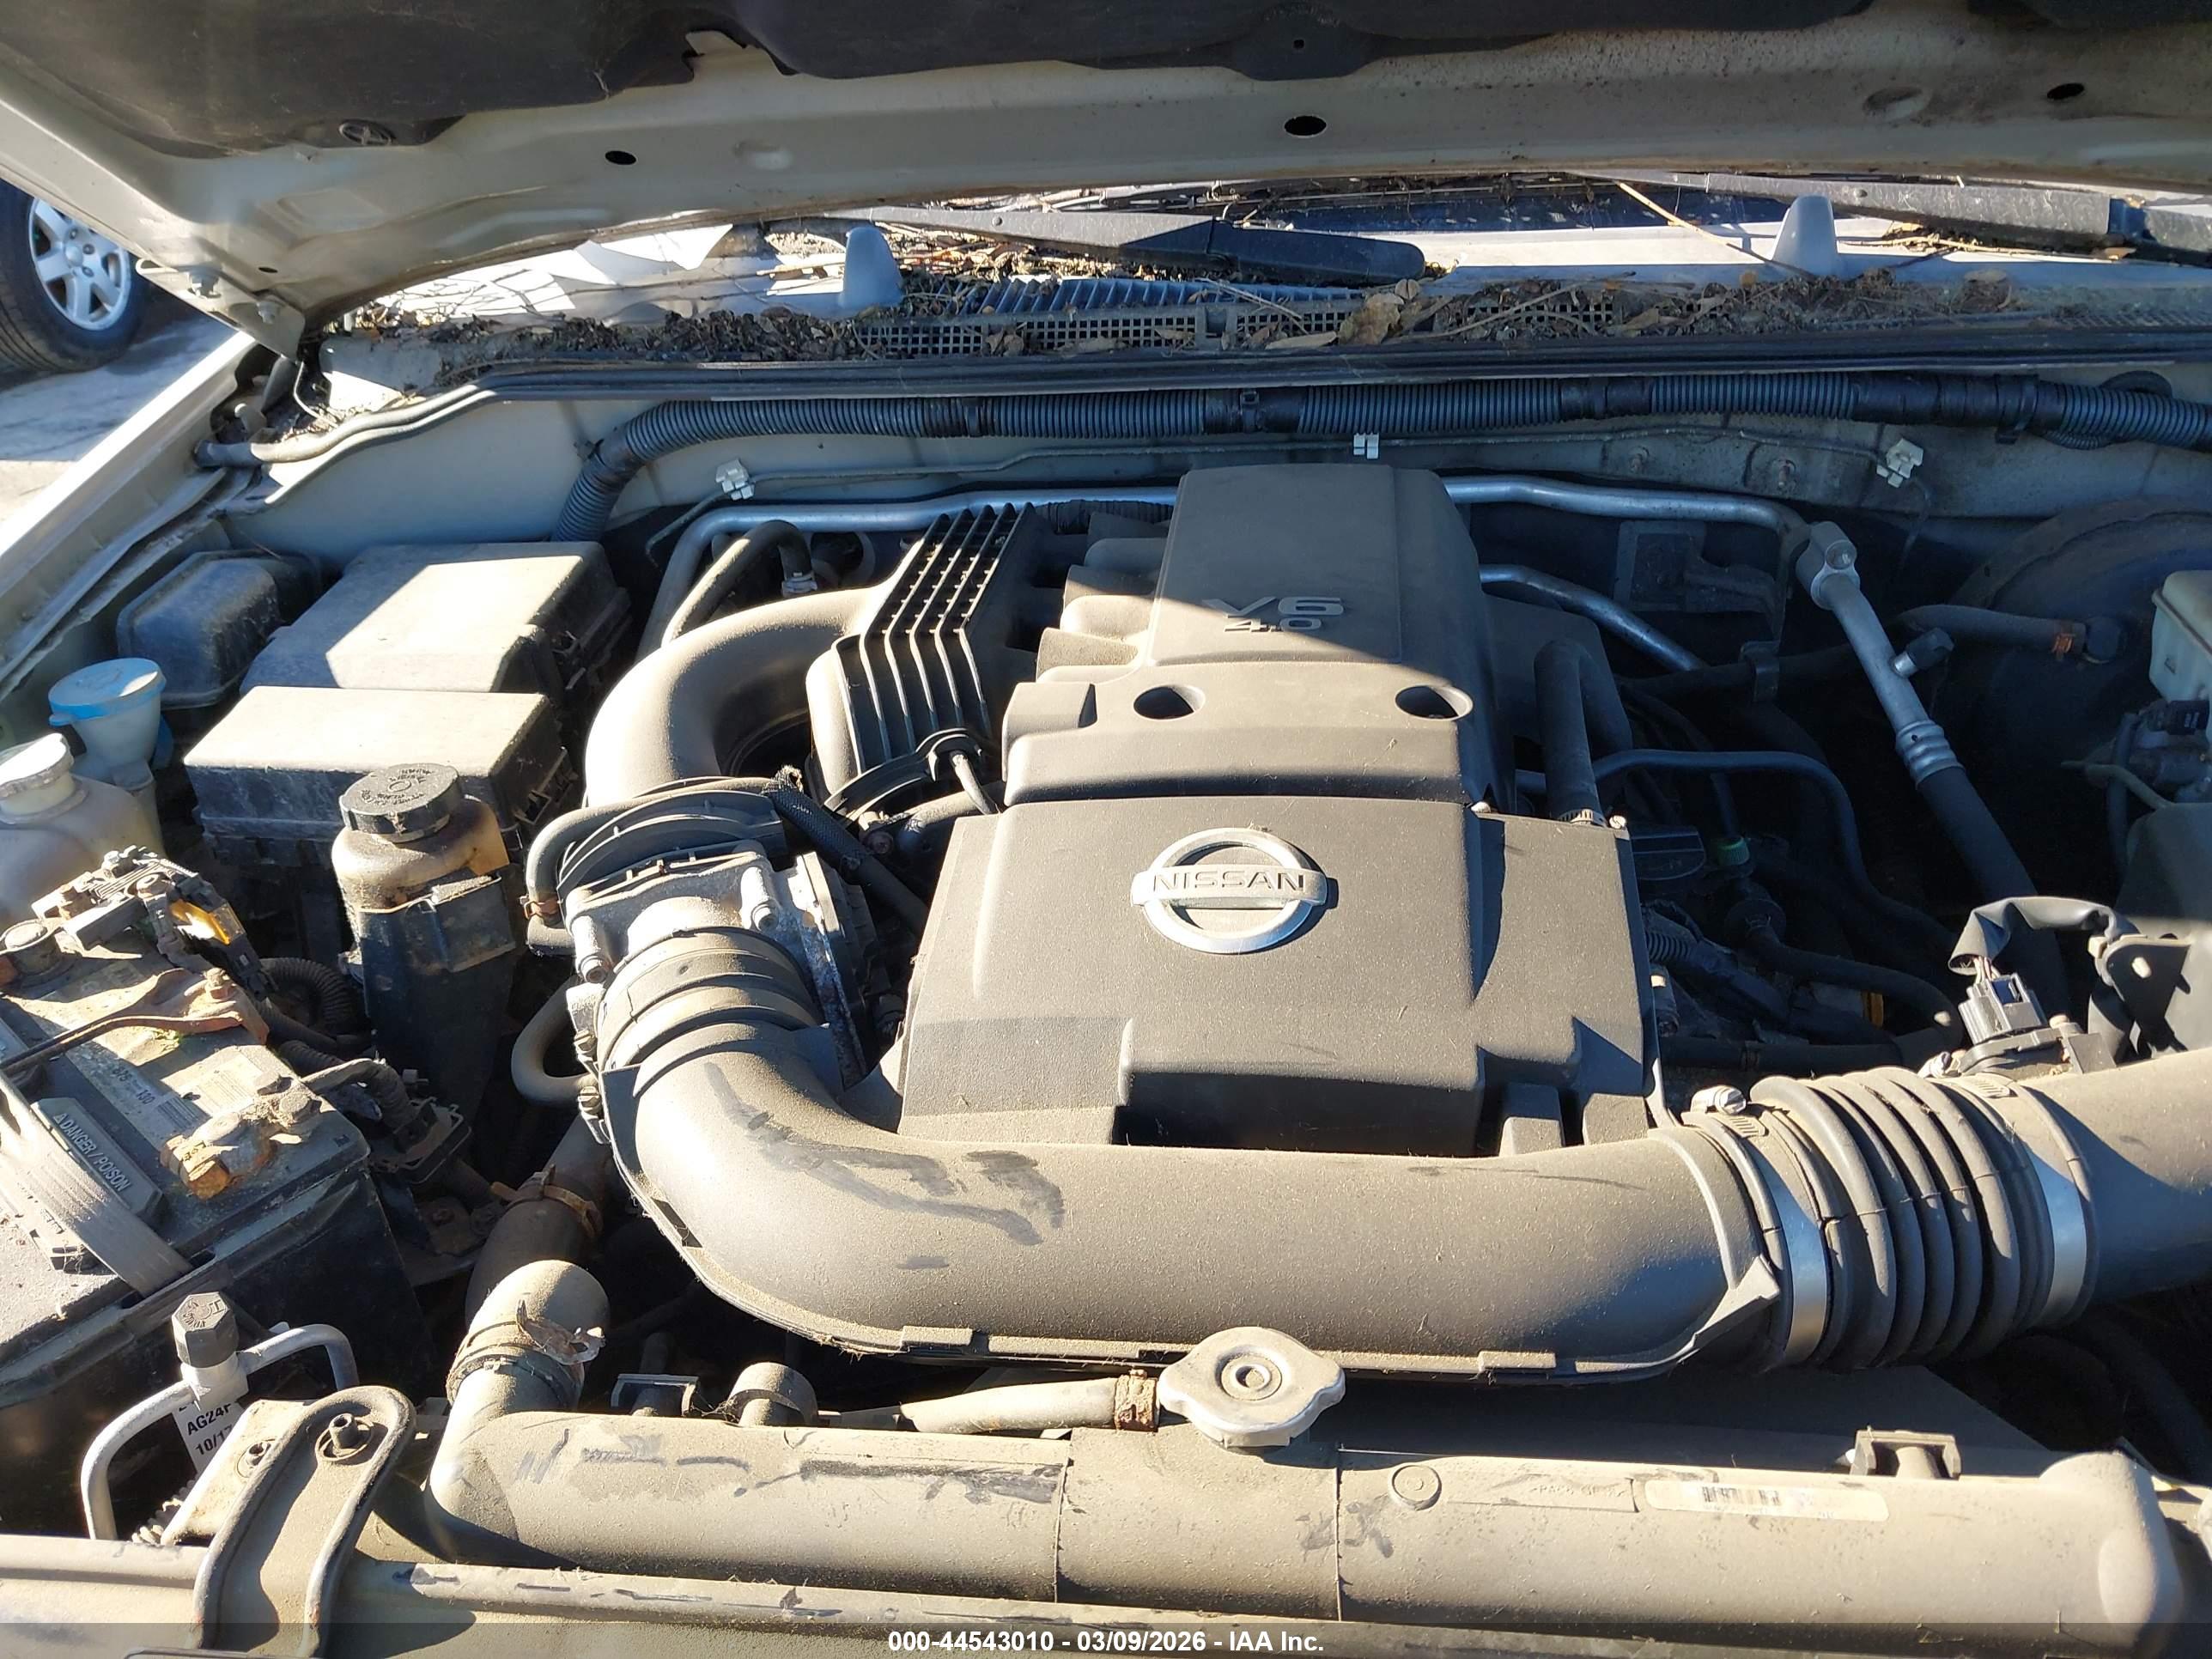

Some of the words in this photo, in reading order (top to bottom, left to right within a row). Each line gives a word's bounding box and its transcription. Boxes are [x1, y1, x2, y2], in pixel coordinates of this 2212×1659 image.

[1202, 596, 1345, 619] V6
[1152, 871, 1305, 894] NISSAN
[58, 1119, 98, 1155] DANGER
[93, 1156, 131, 1192] POISON
